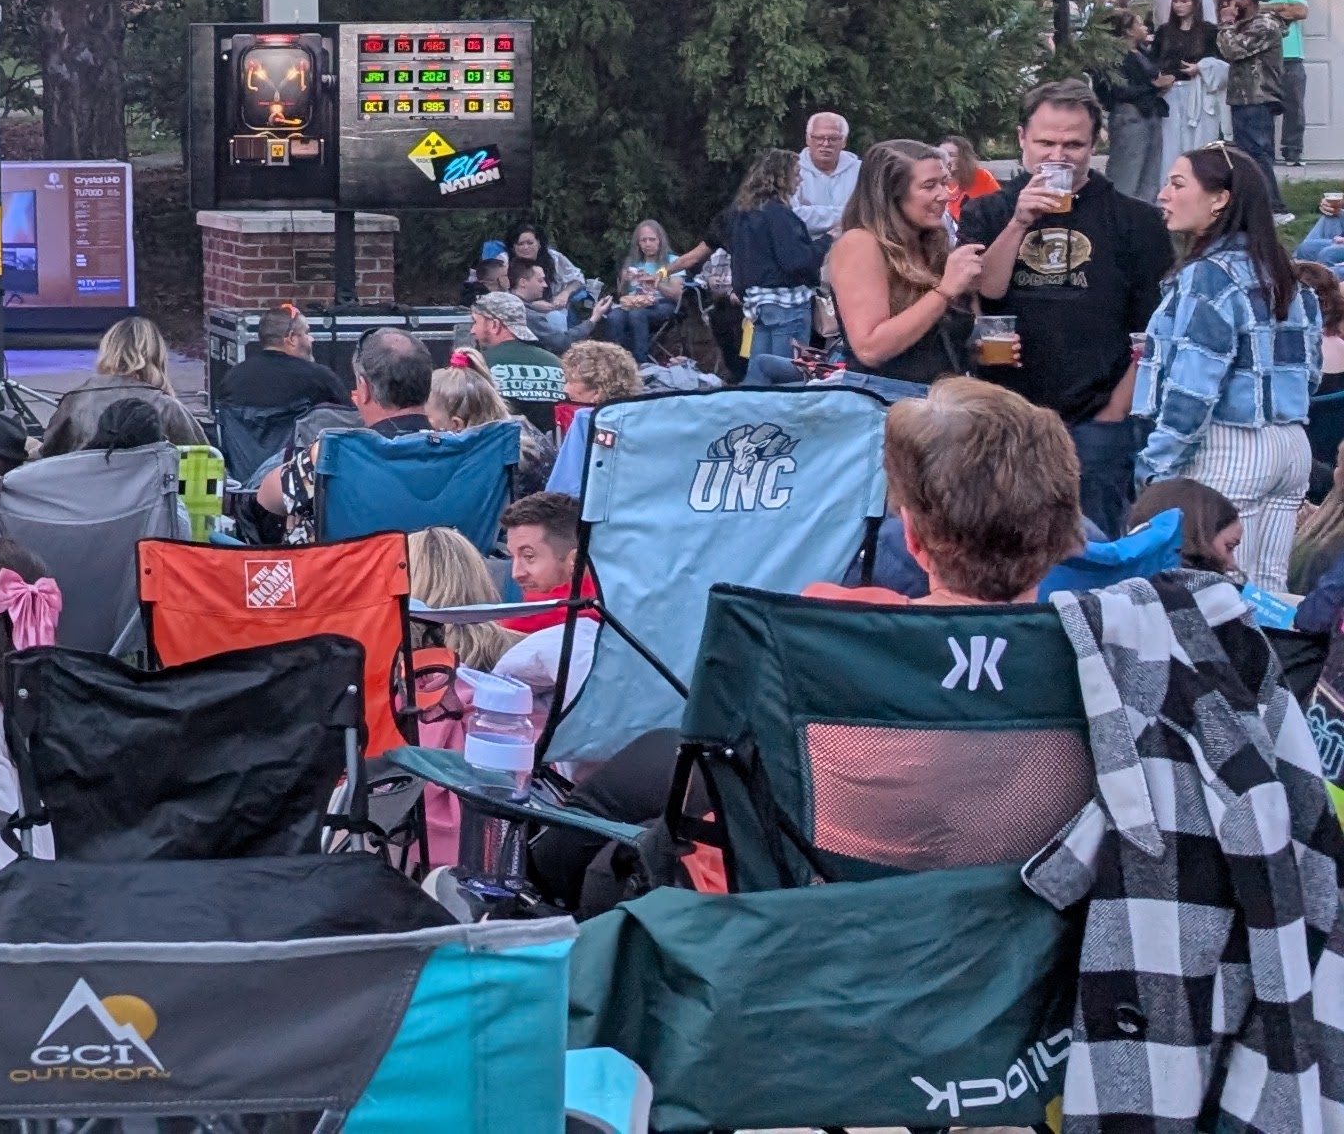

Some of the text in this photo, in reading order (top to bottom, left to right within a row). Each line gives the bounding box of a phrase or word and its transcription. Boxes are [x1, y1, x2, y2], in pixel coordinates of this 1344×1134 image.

[422, 72, 446, 82] 2021
[364, 101, 383, 112] OCT
[422, 101, 445, 112] 1985
[74, 176, 121, 186] Crystal UHD
[439, 166, 501, 195] NATION
[490, 364, 567, 383] SIDE
[498, 390, 551, 399] REWING
[687, 455, 798, 513] UNC
[248, 560, 292, 607] HOME
[251, 565, 272, 585] THE
[266, 577, 293, 607] DEPOT
[29, 1043, 134, 1065] GCI
[9, 1066, 158, 1082] OUTDOOR
